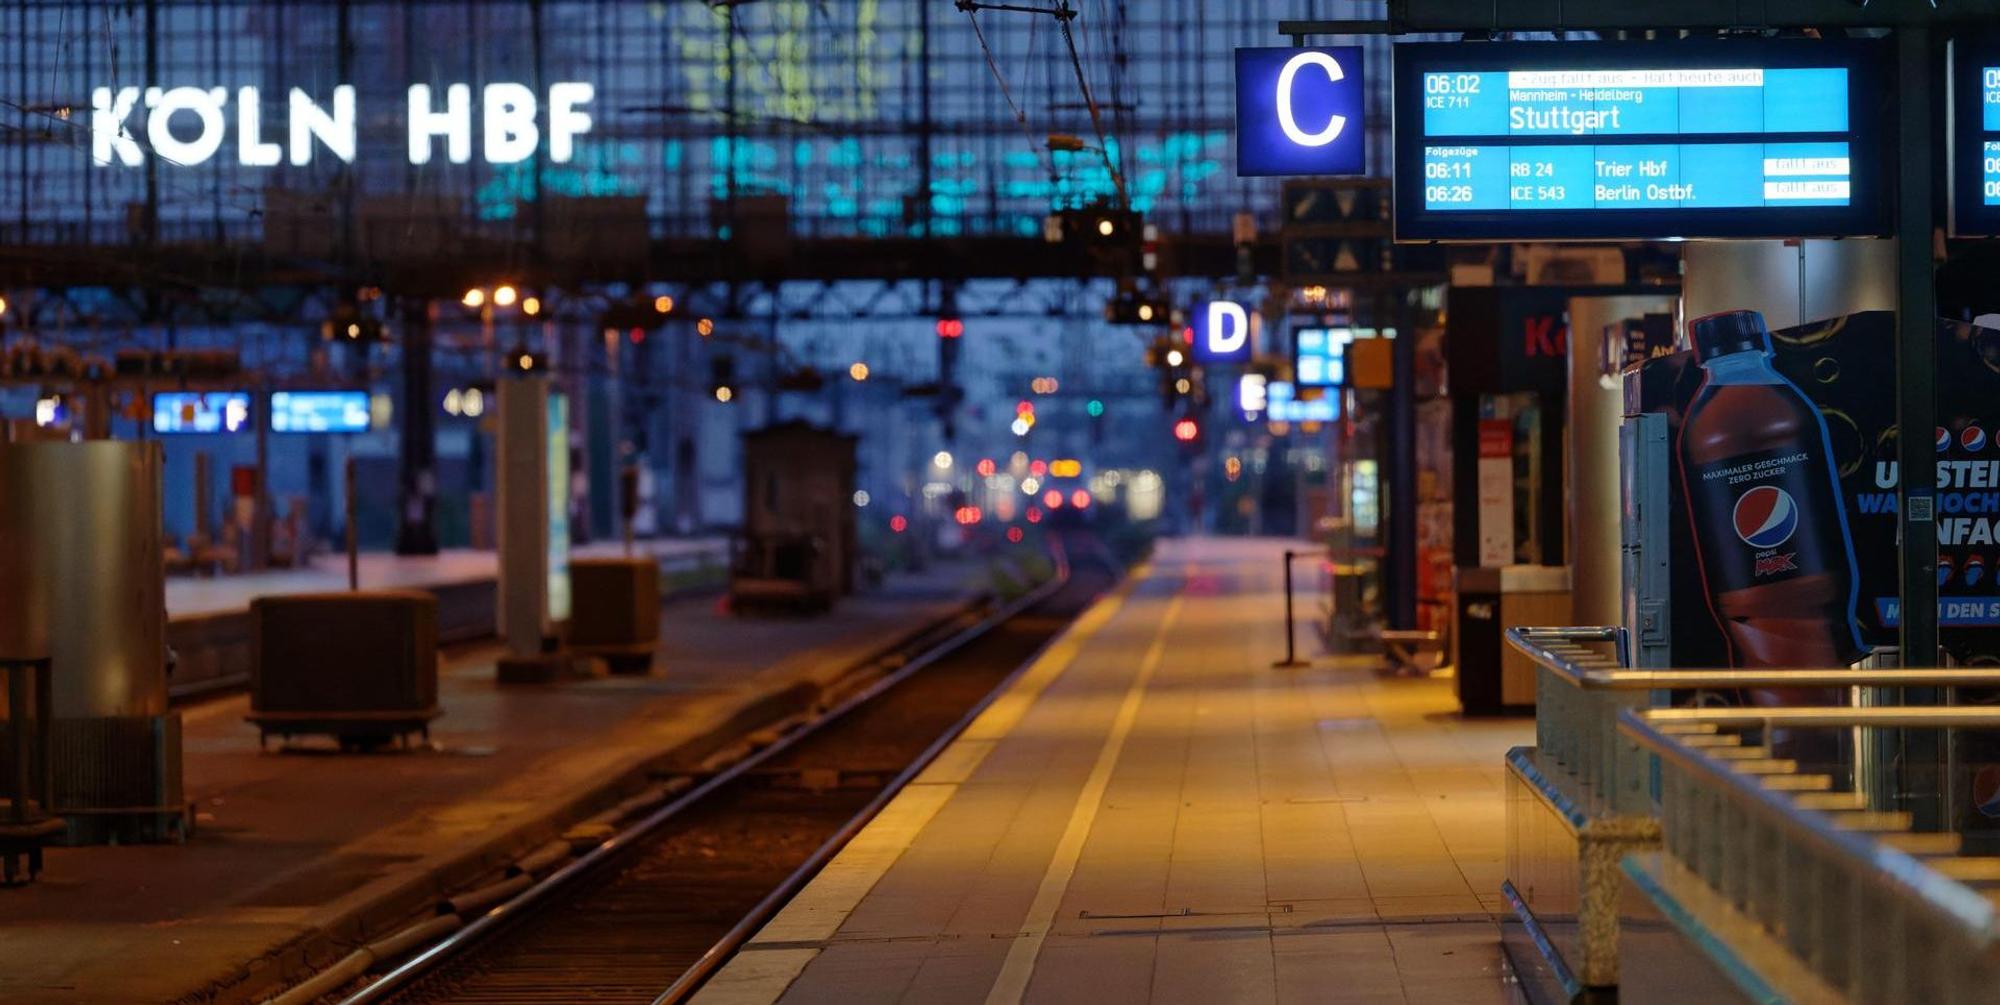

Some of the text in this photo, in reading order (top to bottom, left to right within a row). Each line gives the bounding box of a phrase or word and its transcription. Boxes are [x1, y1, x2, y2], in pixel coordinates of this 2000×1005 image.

[1426, 75, 1480, 94] 06:02
[1598, 73, 1623, 84] aus
[1644, 72, 1673, 83] Halt
[1680, 71, 1722, 82] heute
[1728, 70, 1762, 82] auch
[1276, 52, 1346, 147] C
[1426, 96, 1470, 108] ICE 711
[1510, 90, 1568, 102] Mannheim
[1579, 89, 1643, 104] Heidelberg
[93, 83, 593, 165] KÖLN HBF
[1510, 106, 1620, 134] Stuttgart
[1425, 147, 1478, 157] Folgezüge
[1425, 162, 1471, 179] 06:11
[1511, 163, 1530, 177] RB
[1535, 163, 1554, 177] 24
[1595, 161, 1631, 177] Trier
[1639, 160, 1667, 177] Hbf
[1812, 158, 1837, 169] aus
[1426, 186, 1473, 203] 06:26
[1511, 187, 1533, 201] ICE
[1538, 186, 1565, 201] 543
[1595, 185, 1640, 201] Berlin
[1647, 183, 1697, 201] Ostbf.
[1812, 183, 1837, 193] aus
[1208, 301, 1248, 353] D
[1702, 453, 1808, 480] MAXIMALER GESCHMACK
[1728, 467, 1786, 485] ZERO ZUCKER
[1755, 549, 1777, 559] pepsi
[1947, 603, 1985, 618] DEN
